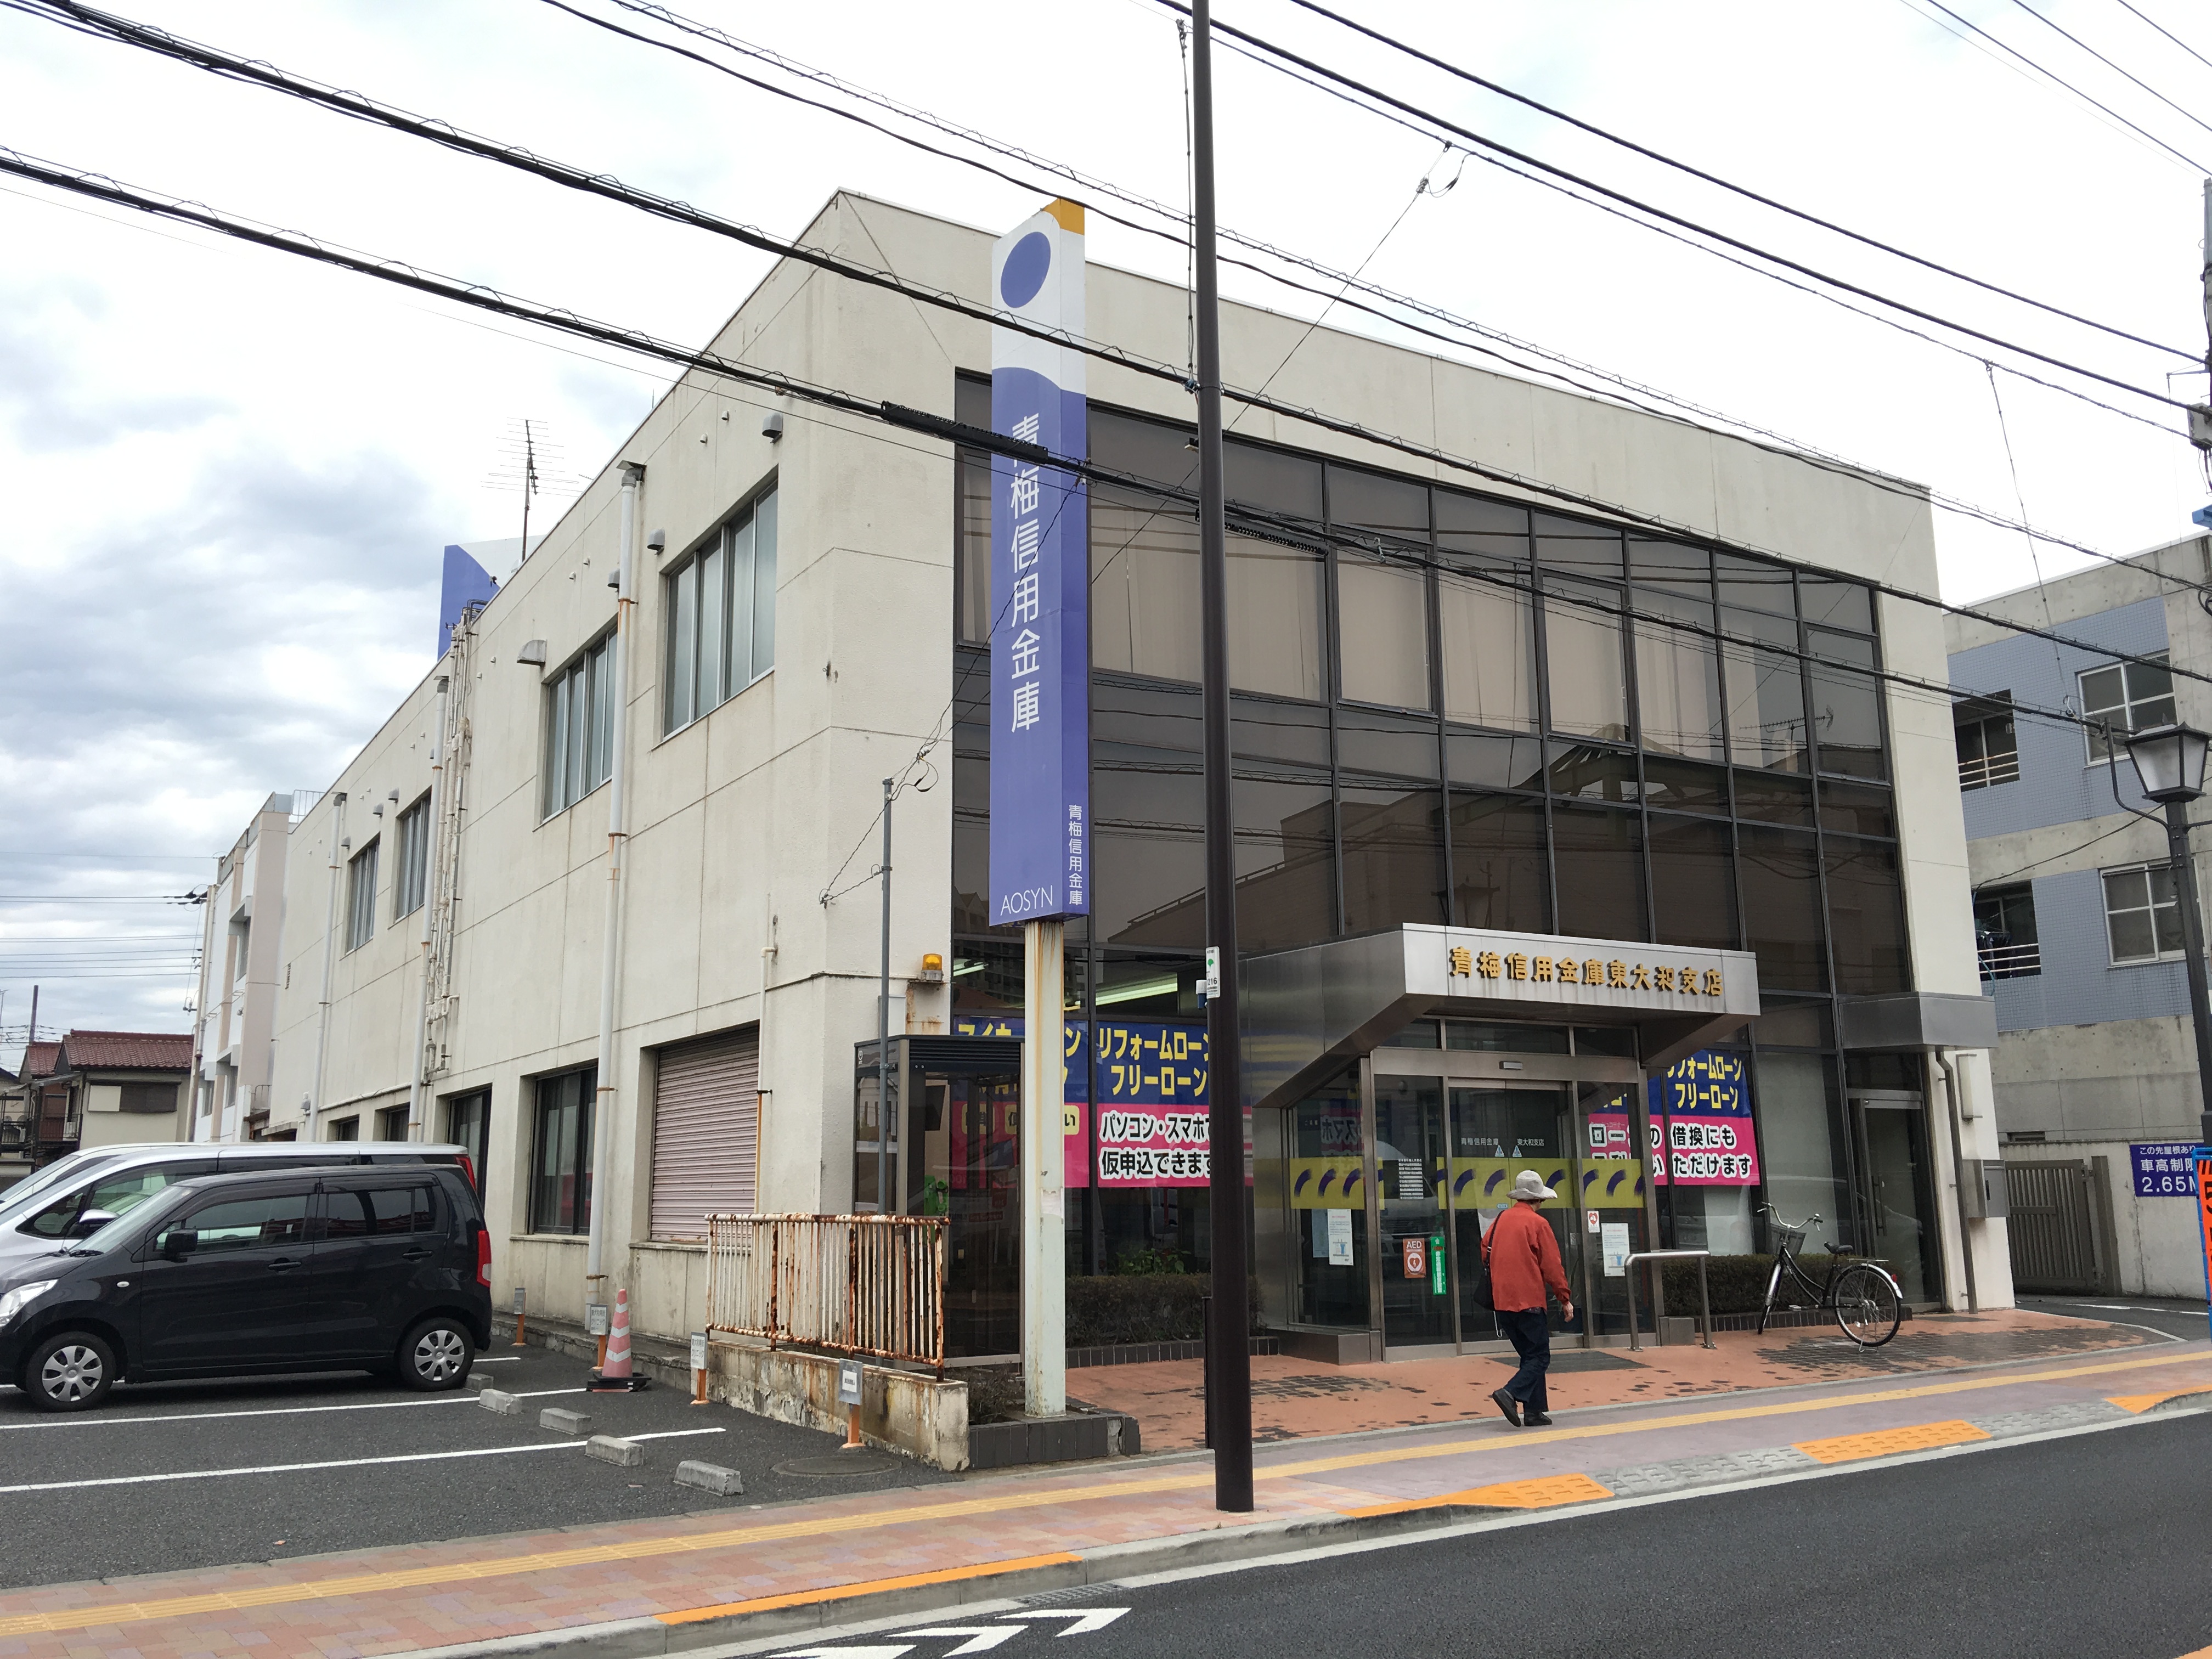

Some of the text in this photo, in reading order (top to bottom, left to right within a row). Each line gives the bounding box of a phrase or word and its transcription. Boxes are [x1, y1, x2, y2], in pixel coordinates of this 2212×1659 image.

[1011, 413, 1040, 732] 青梅信用金庫
[1068, 804, 1083, 906] 青梅信用金庫
[1000, 885, 1053, 916] AOSYN
[1450, 946, 1724, 996] 青梅信用金庫東大和支店
[1110, 1064, 1207, 1097] フリーローン
[1667, 1053, 1742, 1081] ォームローン
[1675, 1082, 1738, 1110] フリーローン
[1103, 1113, 1210, 1140] パソコン・スマホ
[1406, 1240, 1422, 1249] AED
